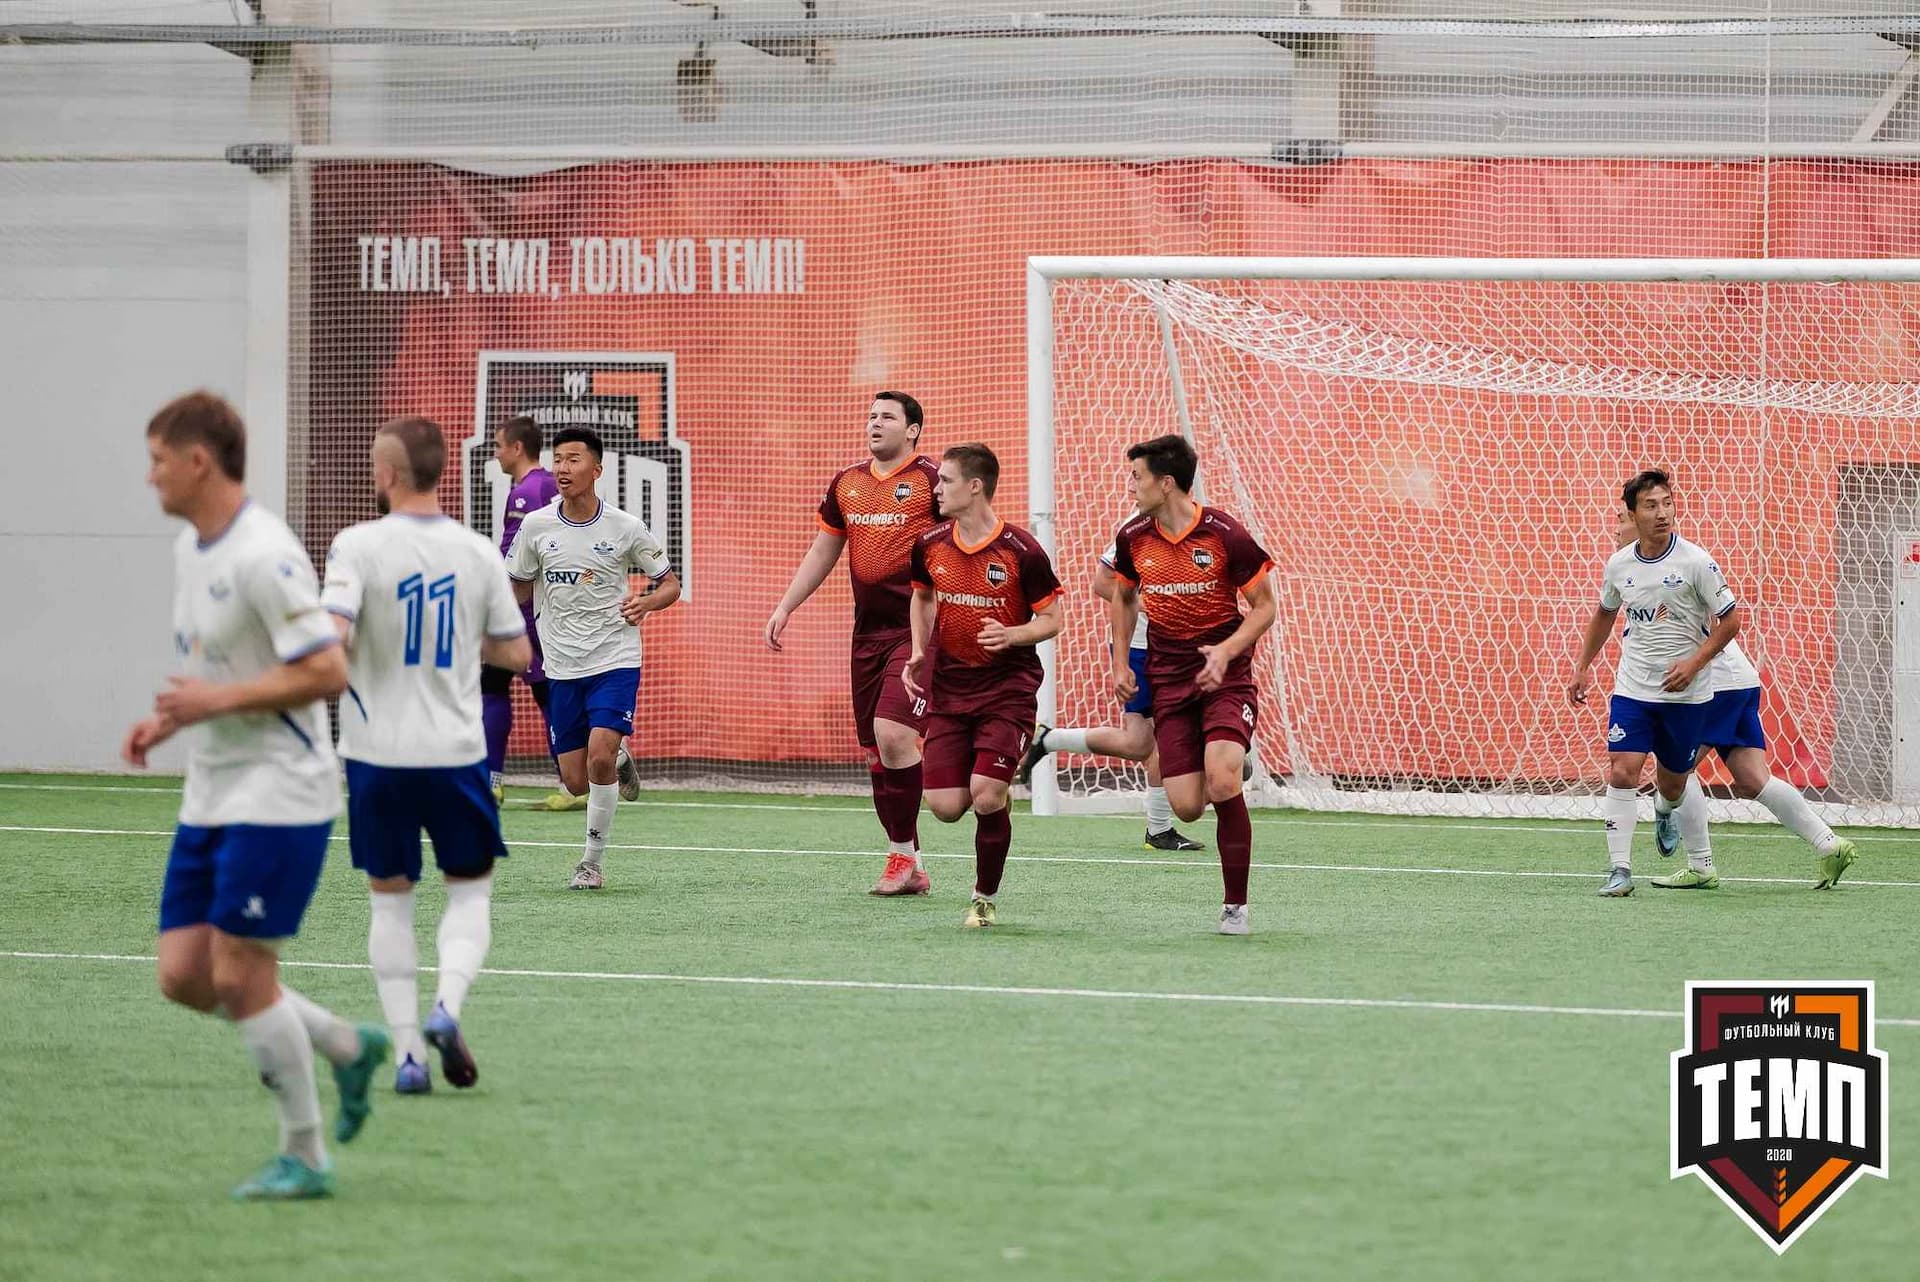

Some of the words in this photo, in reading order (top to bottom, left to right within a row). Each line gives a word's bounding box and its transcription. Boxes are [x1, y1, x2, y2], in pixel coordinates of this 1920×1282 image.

[358, 236, 449, 299] ТЕМП,
[463, 238, 560, 300] ТЕМП,
[570, 237, 696, 294] ТОЛЬКО
[706, 237, 804, 294] ТЕМП!
[519, 402, 599, 424] ТБОЛЬНЫЙ
[846, 513, 909, 526] РОДИНВЕСТ
[545, 570, 580, 585] GNV
[1144, 579, 1219, 596] РОДИНВЕСТ
[397, 572, 456, 668] 11
[912, 697, 927, 716] 13
